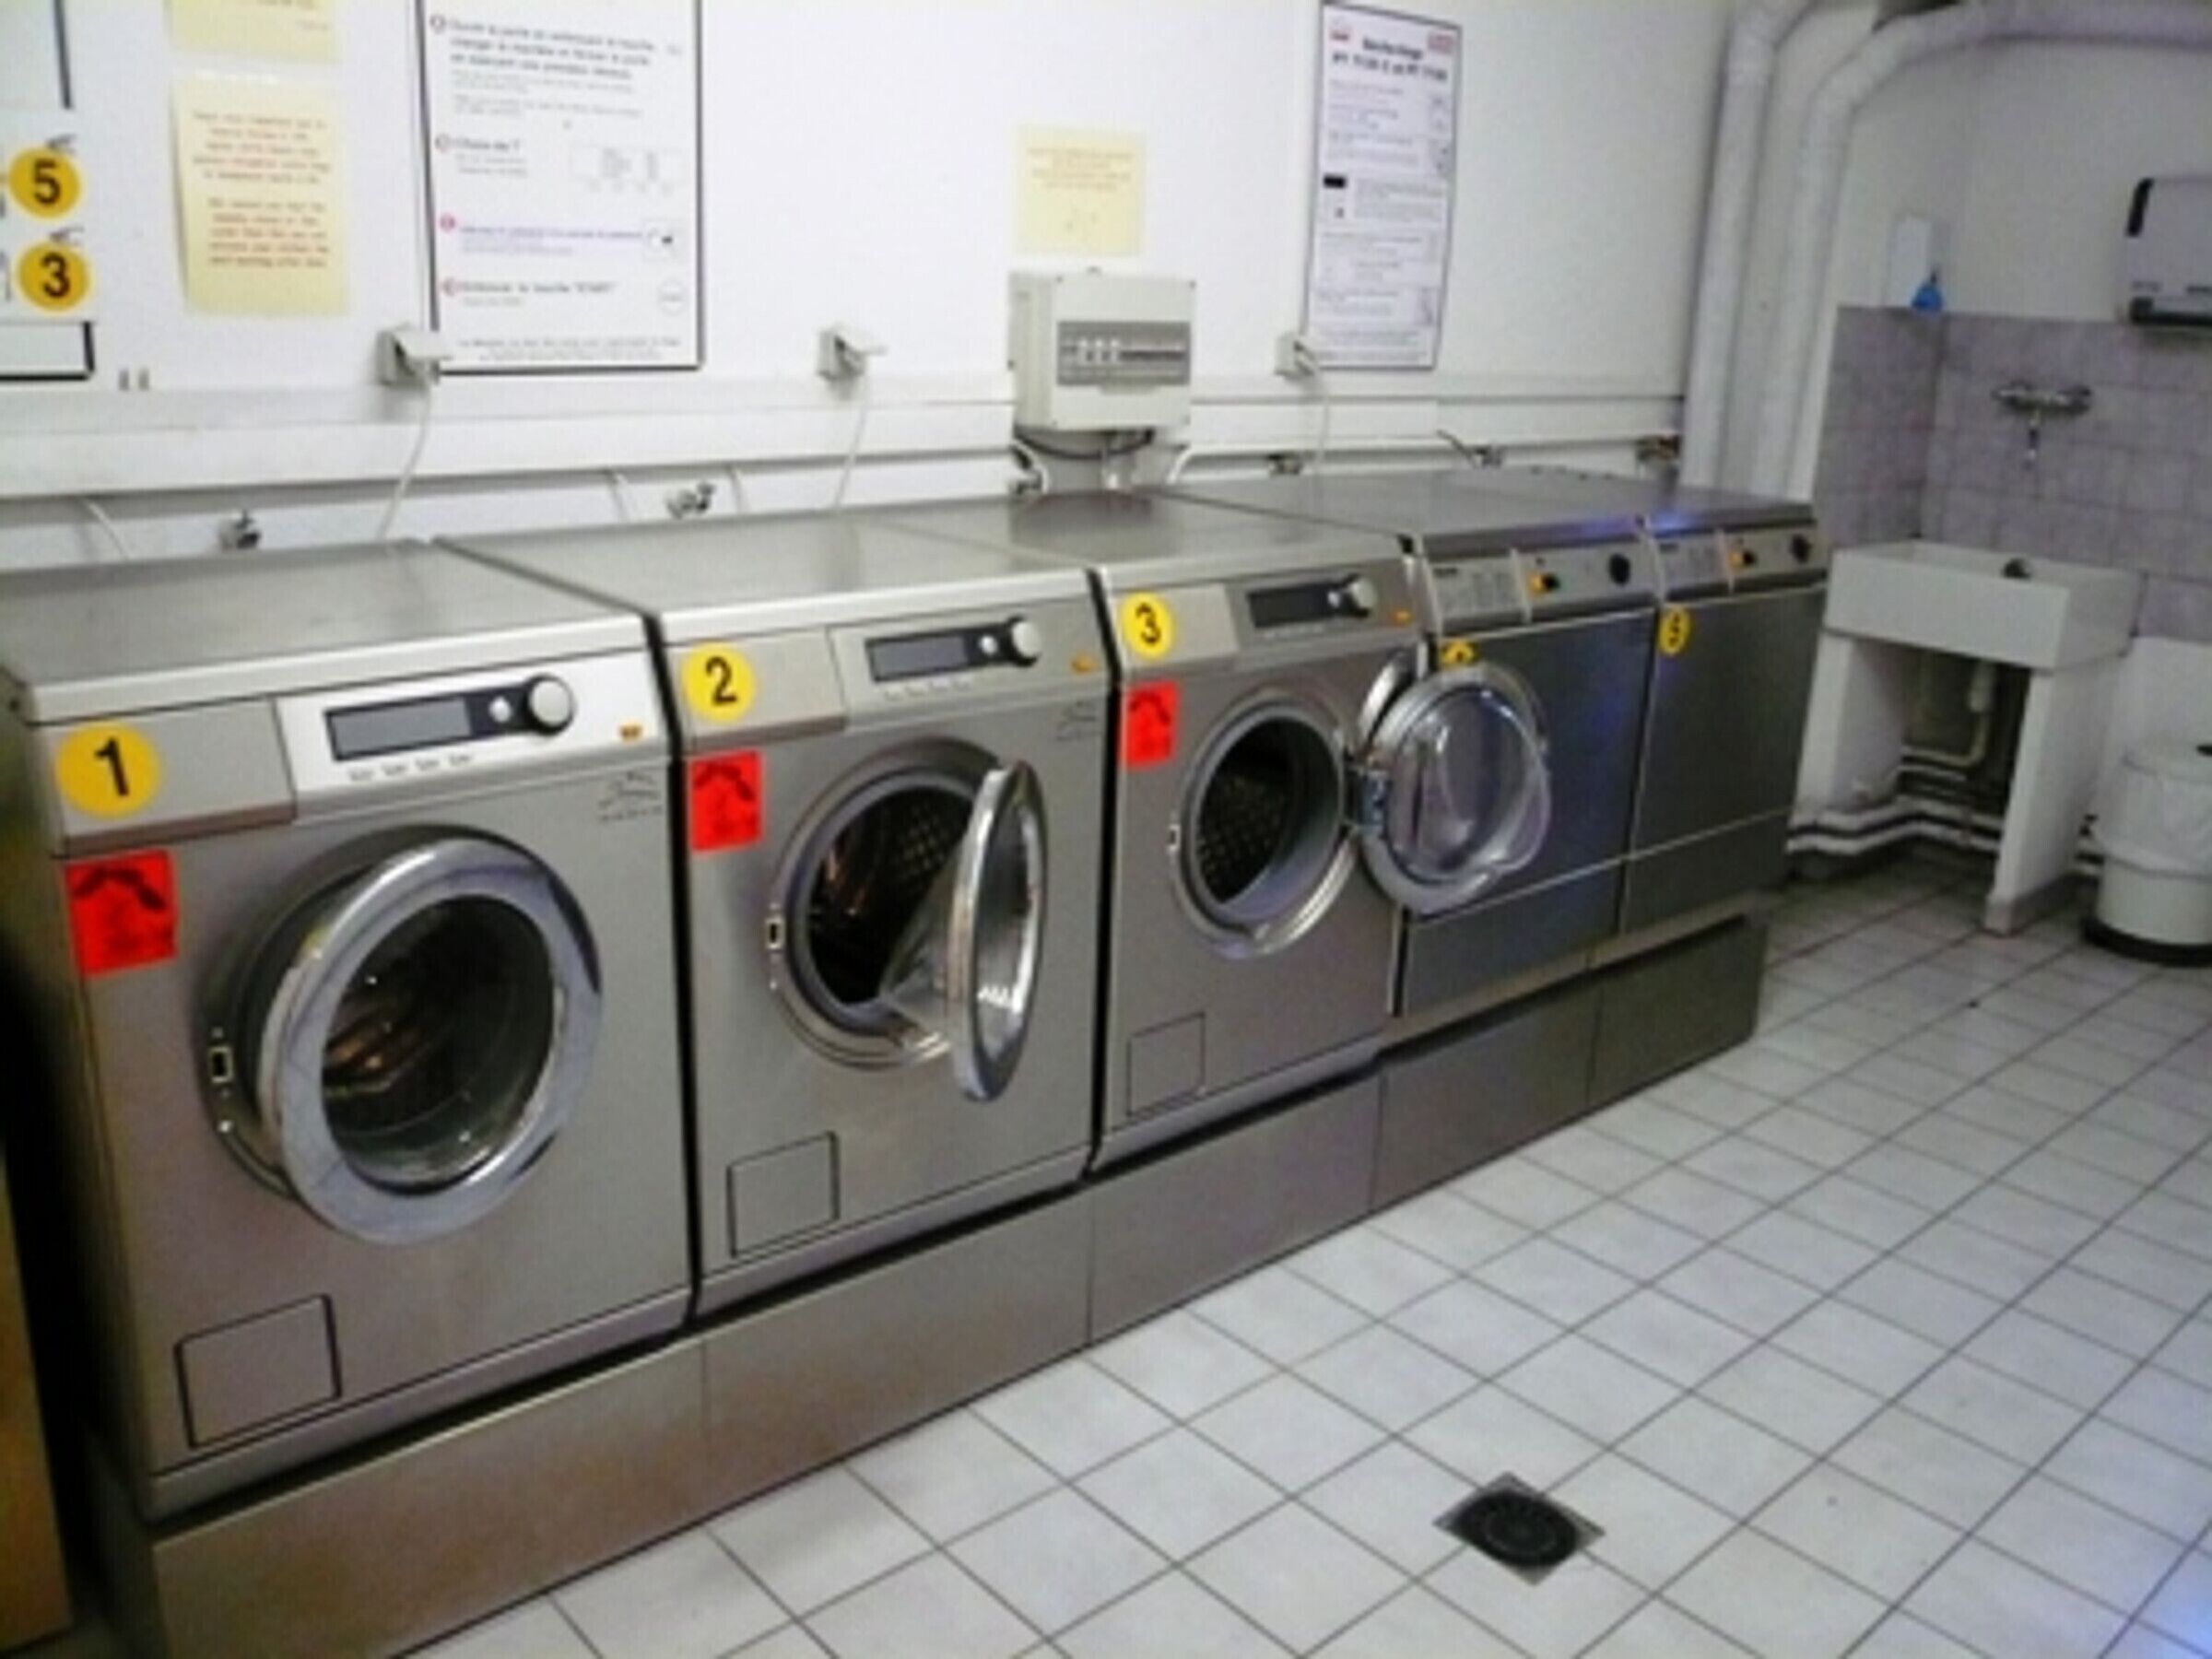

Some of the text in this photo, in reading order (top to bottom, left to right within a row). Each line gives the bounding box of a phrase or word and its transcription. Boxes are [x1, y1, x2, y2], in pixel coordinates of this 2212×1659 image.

[33, 158, 62, 206] 5
[40, 252, 70, 298] 3
[1135, 602, 1161, 646] 3
[705, 655, 738, 707] 2
[94, 737, 130, 796] 1
